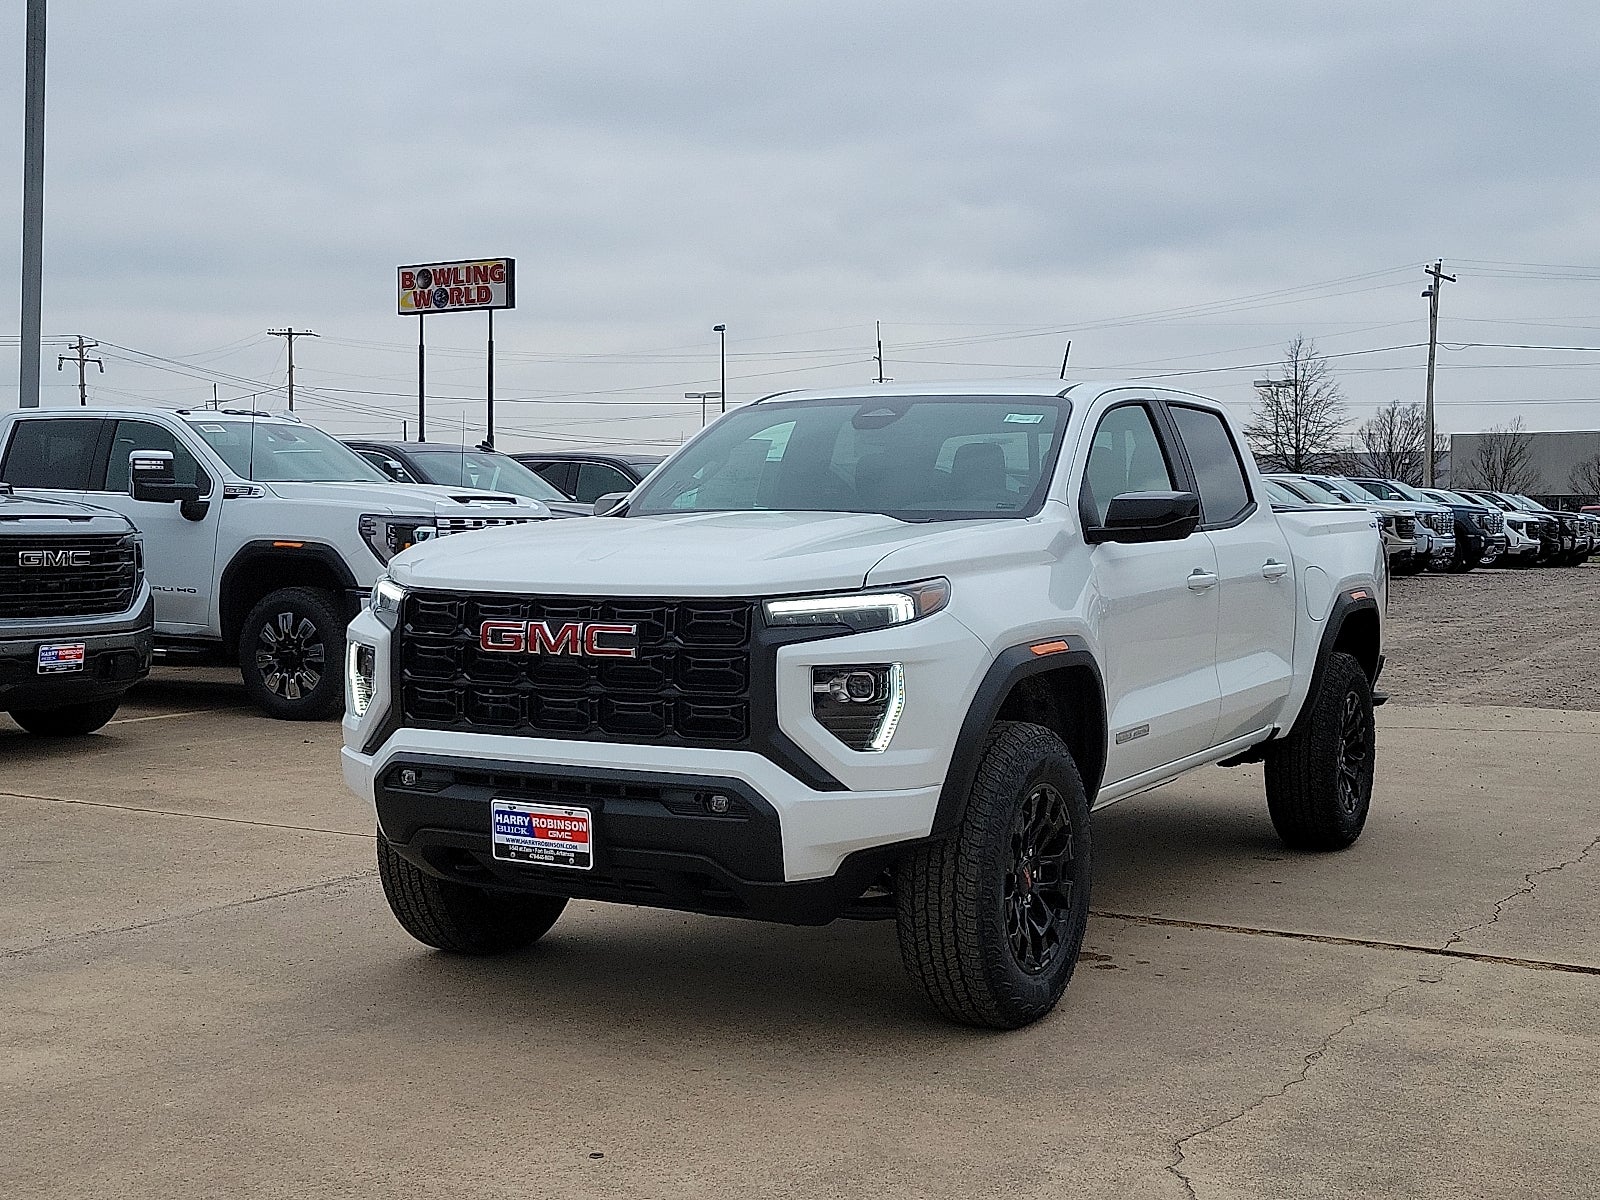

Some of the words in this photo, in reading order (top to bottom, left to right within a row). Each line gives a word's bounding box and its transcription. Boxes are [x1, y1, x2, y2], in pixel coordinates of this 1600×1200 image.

[401, 263, 505, 290] BOWLING
[412, 285, 492, 309] WORLD
[19, 550, 90, 567] GMC
[480, 620, 637, 658] GMC
[495, 813, 531, 827] HARRY
[532, 817, 587, 832] ROBINSON
[496, 824, 530, 835] BUICK
[548, 830, 573, 840] GMC
